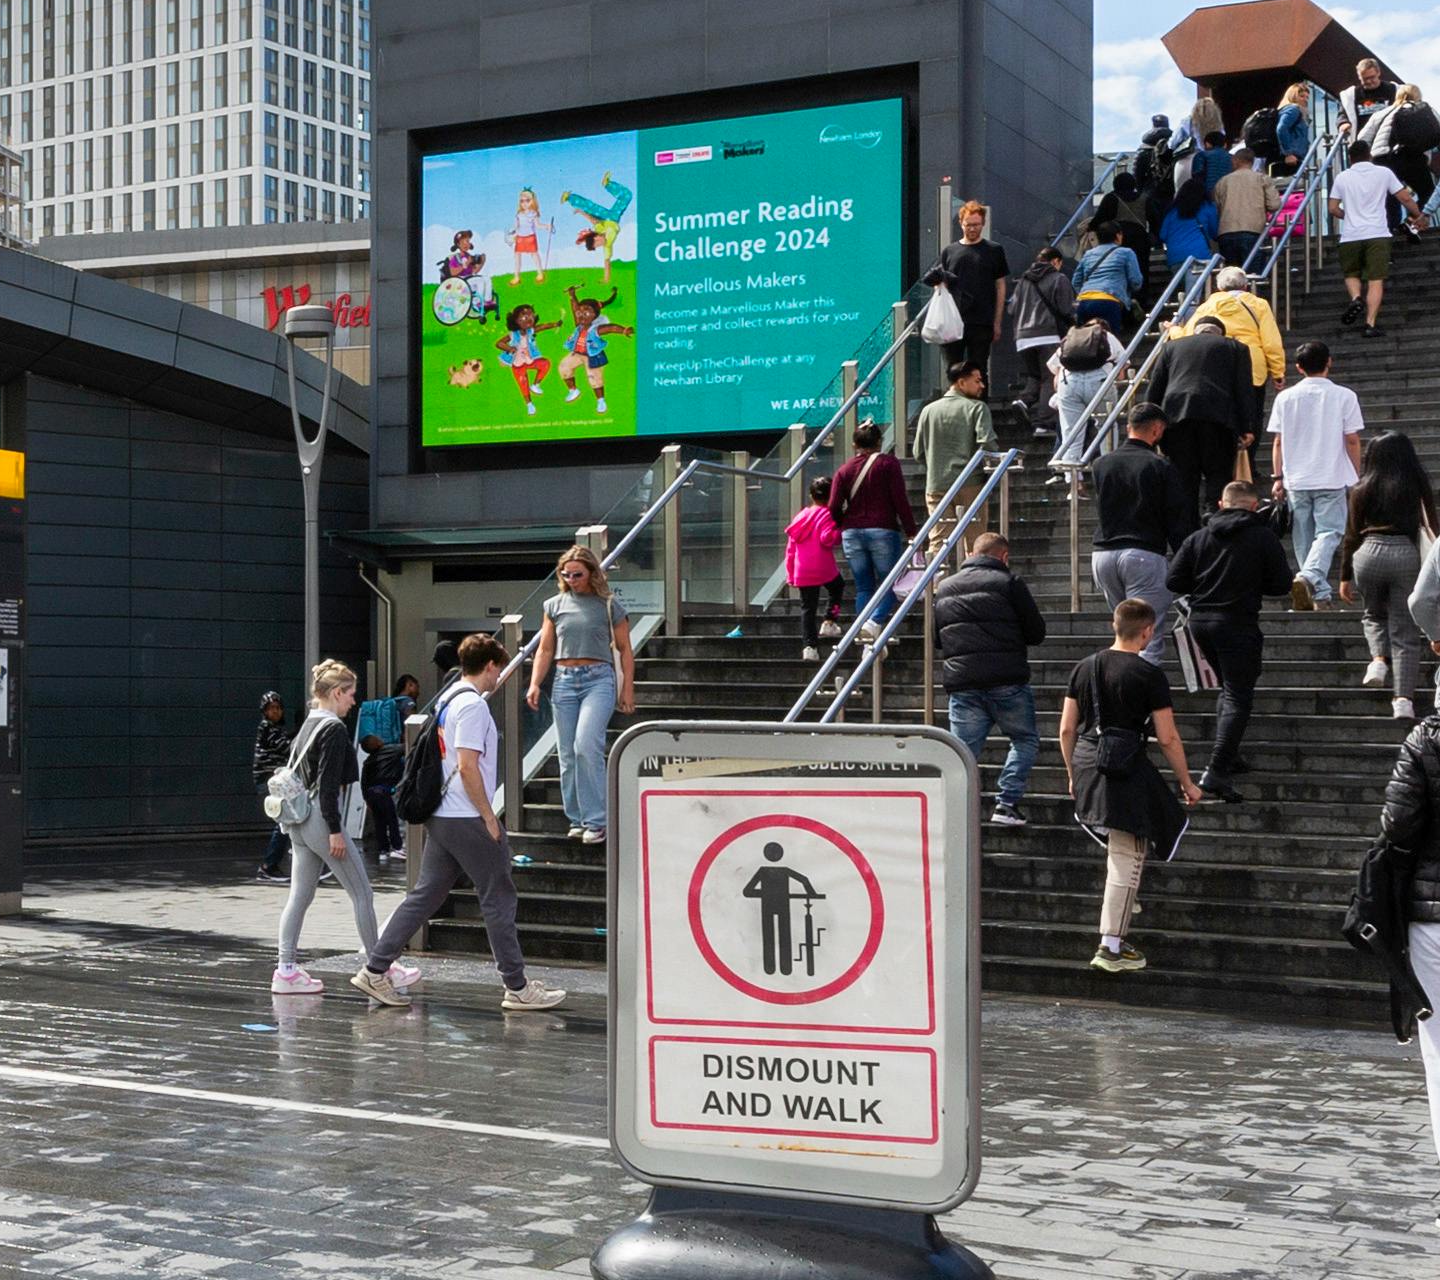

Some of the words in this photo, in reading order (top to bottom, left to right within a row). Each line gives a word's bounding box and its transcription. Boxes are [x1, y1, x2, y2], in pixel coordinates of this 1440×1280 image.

[654, 208, 750, 233] Summer
[757, 194, 854, 223] Reading
[654, 235, 767, 263] Challenge
[775, 227, 830, 252] 2024
[654, 277, 742, 297] Marvellous
[746, 272, 807, 289] Makers
[260, 282, 371, 332] Wfiel
[654, 308, 699, 320] Become
[701, 308, 708, 317] a
[710, 301, 772, 316] Marvellous
[774, 297, 811, 311] Maker
[813, 295, 836, 308] this
[654, 324, 698, 335] summer
[701, 318, 722, 331] and
[724, 316, 763, 330] collect
[765, 312, 810, 327] rewards
[812, 310, 831, 323] for
[833, 311, 861, 326] your
[654, 355, 779, 373] #KeepUpTheChallenge
[781, 354, 793, 364] at
[795, 353, 816, 366] any
[653, 375, 703, 387] Newham
[706, 372, 744, 386] Library
[770, 399, 790, 410] WE
[792, 398, 817, 409] ARE
[643, 755, 659, 771] IN
[702, 1053, 881, 1087] DISMOUNT
[701, 1090, 772, 1118] AND
[782, 1094, 884, 1125] WALK
